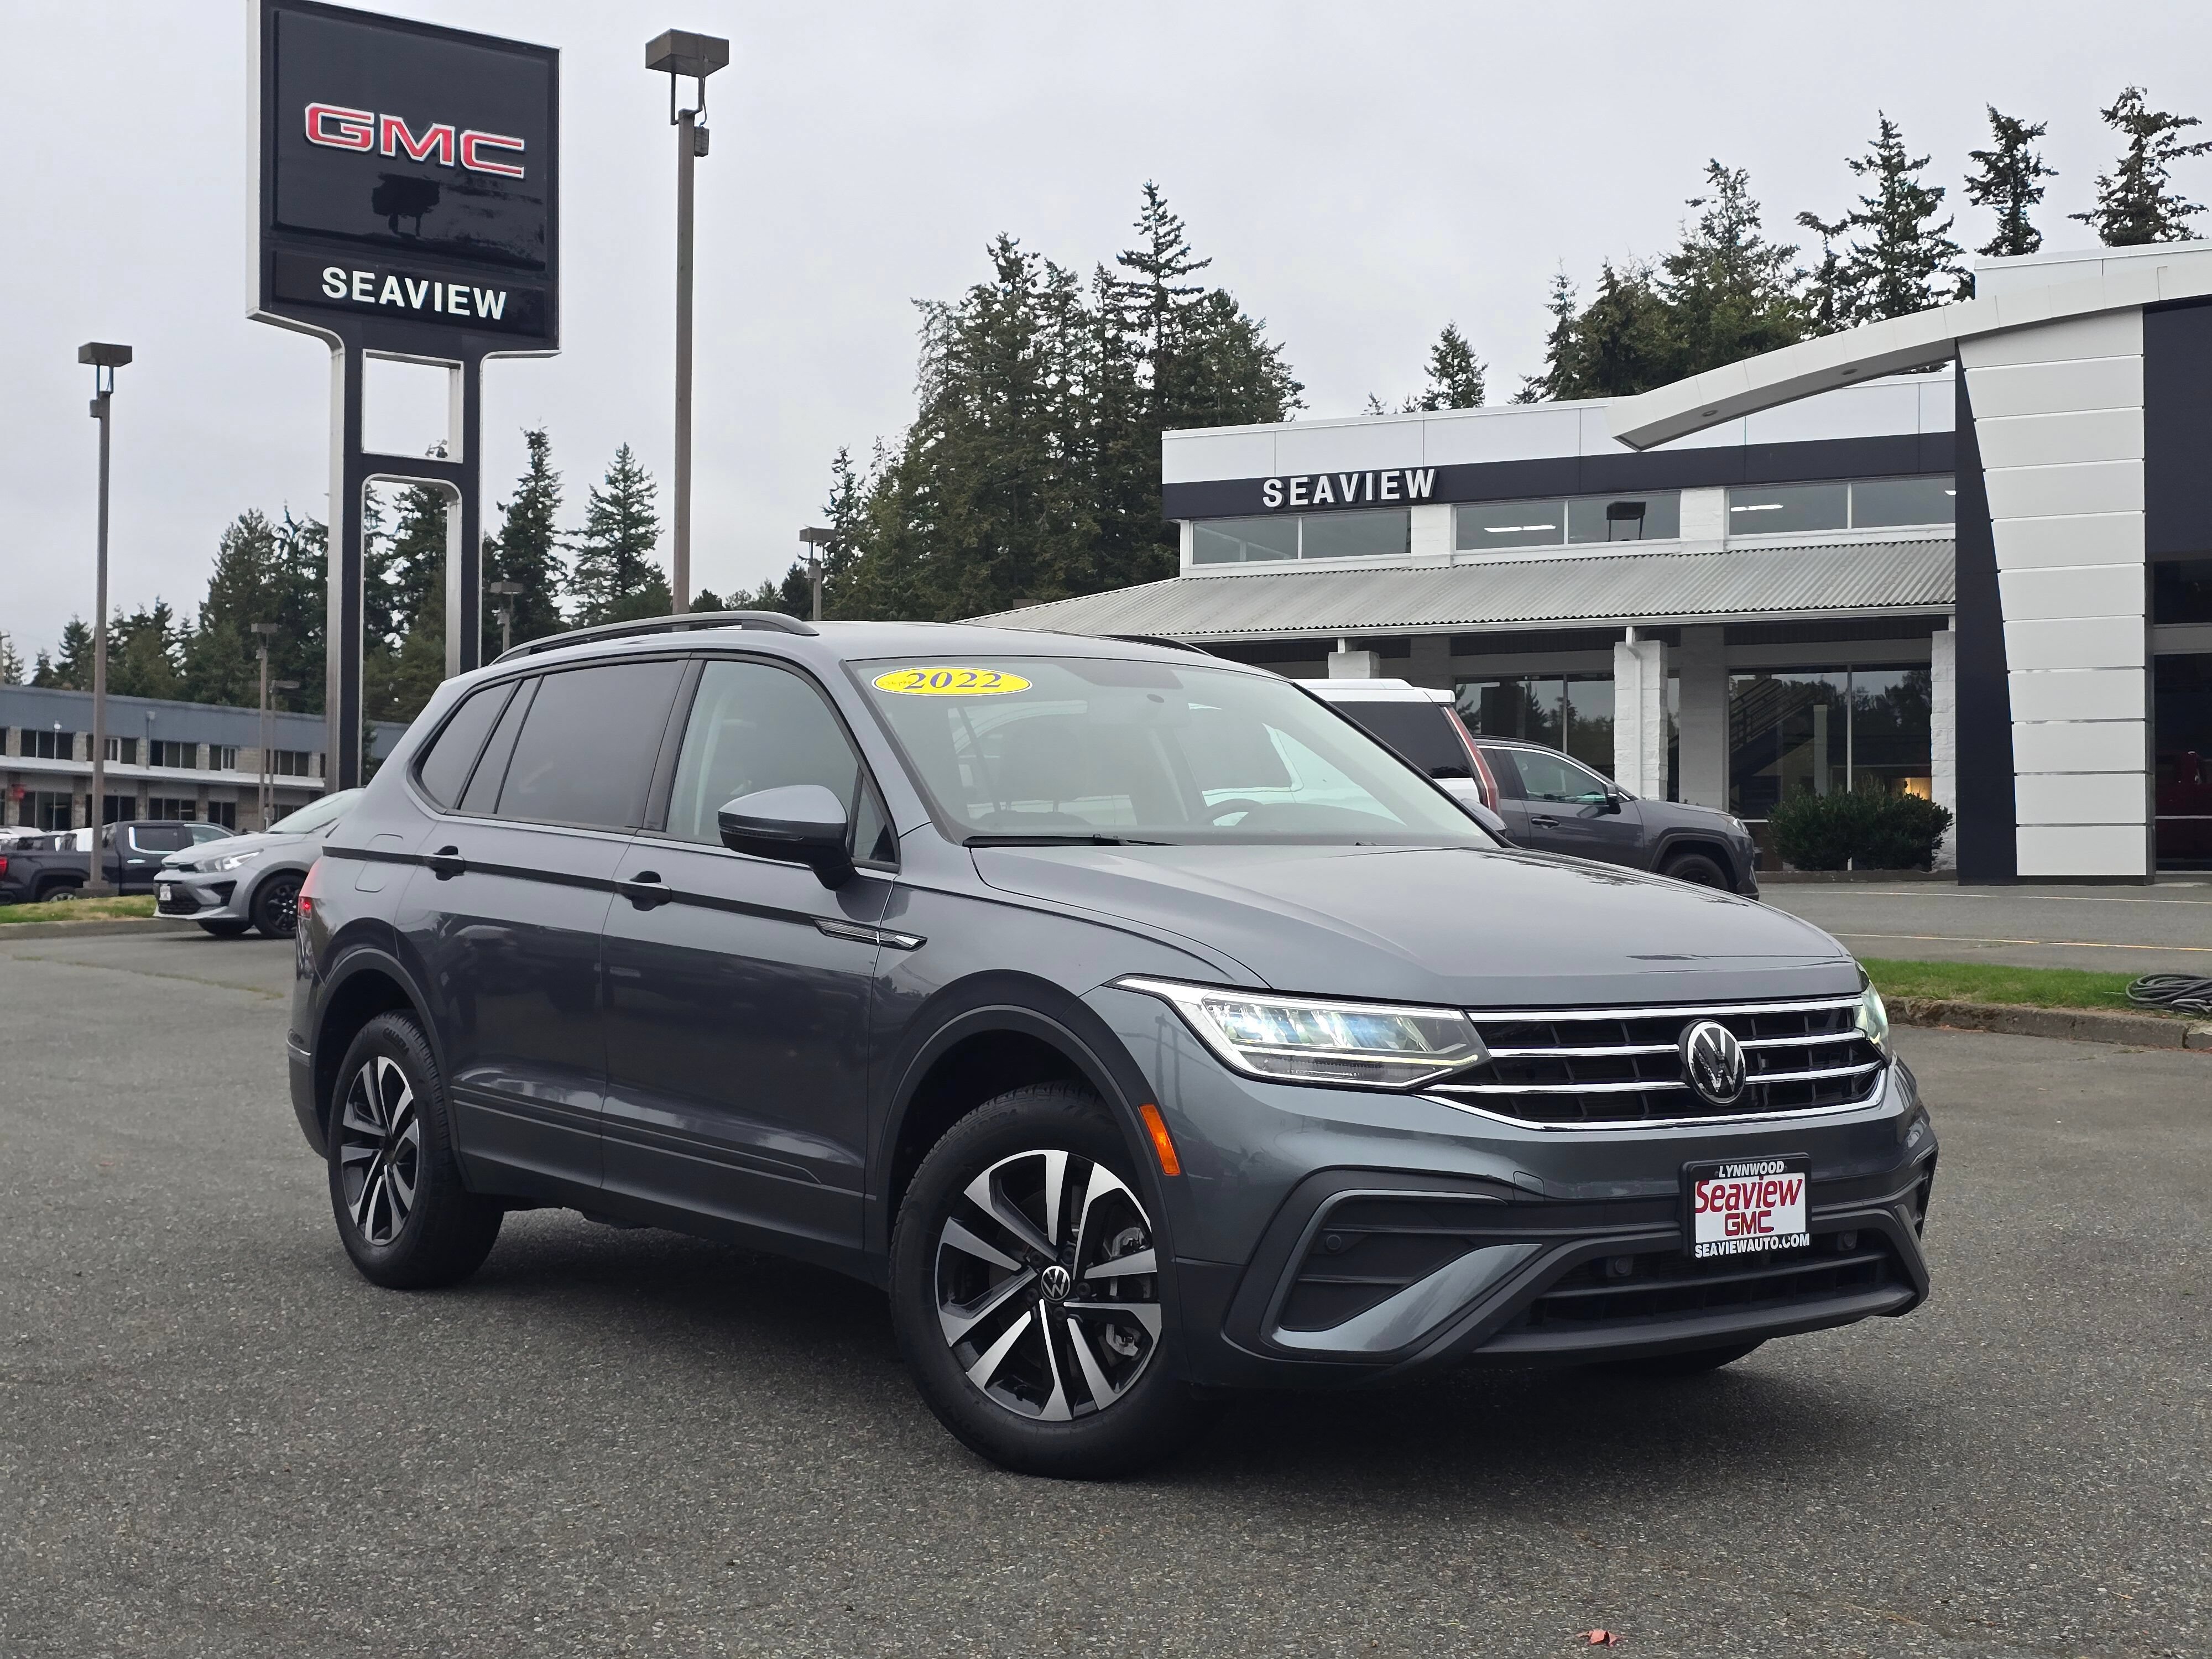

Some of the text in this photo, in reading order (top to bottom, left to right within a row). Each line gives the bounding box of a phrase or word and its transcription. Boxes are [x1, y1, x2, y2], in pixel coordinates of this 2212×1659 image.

[305, 102, 524, 178] GMC
[322, 267, 506, 320] SEAVIEW
[1262, 469, 1436, 508] SEAVIEW
[903, 672, 1002, 689] 2022
[1719, 1161, 1785, 1178] LYNNWOOD
[1695, 1176, 1803, 1213] Seaview
[1725, 1210, 1774, 1237] GMC
[1695, 1233, 1810, 1259] SEAVIEWAUTO.COM
